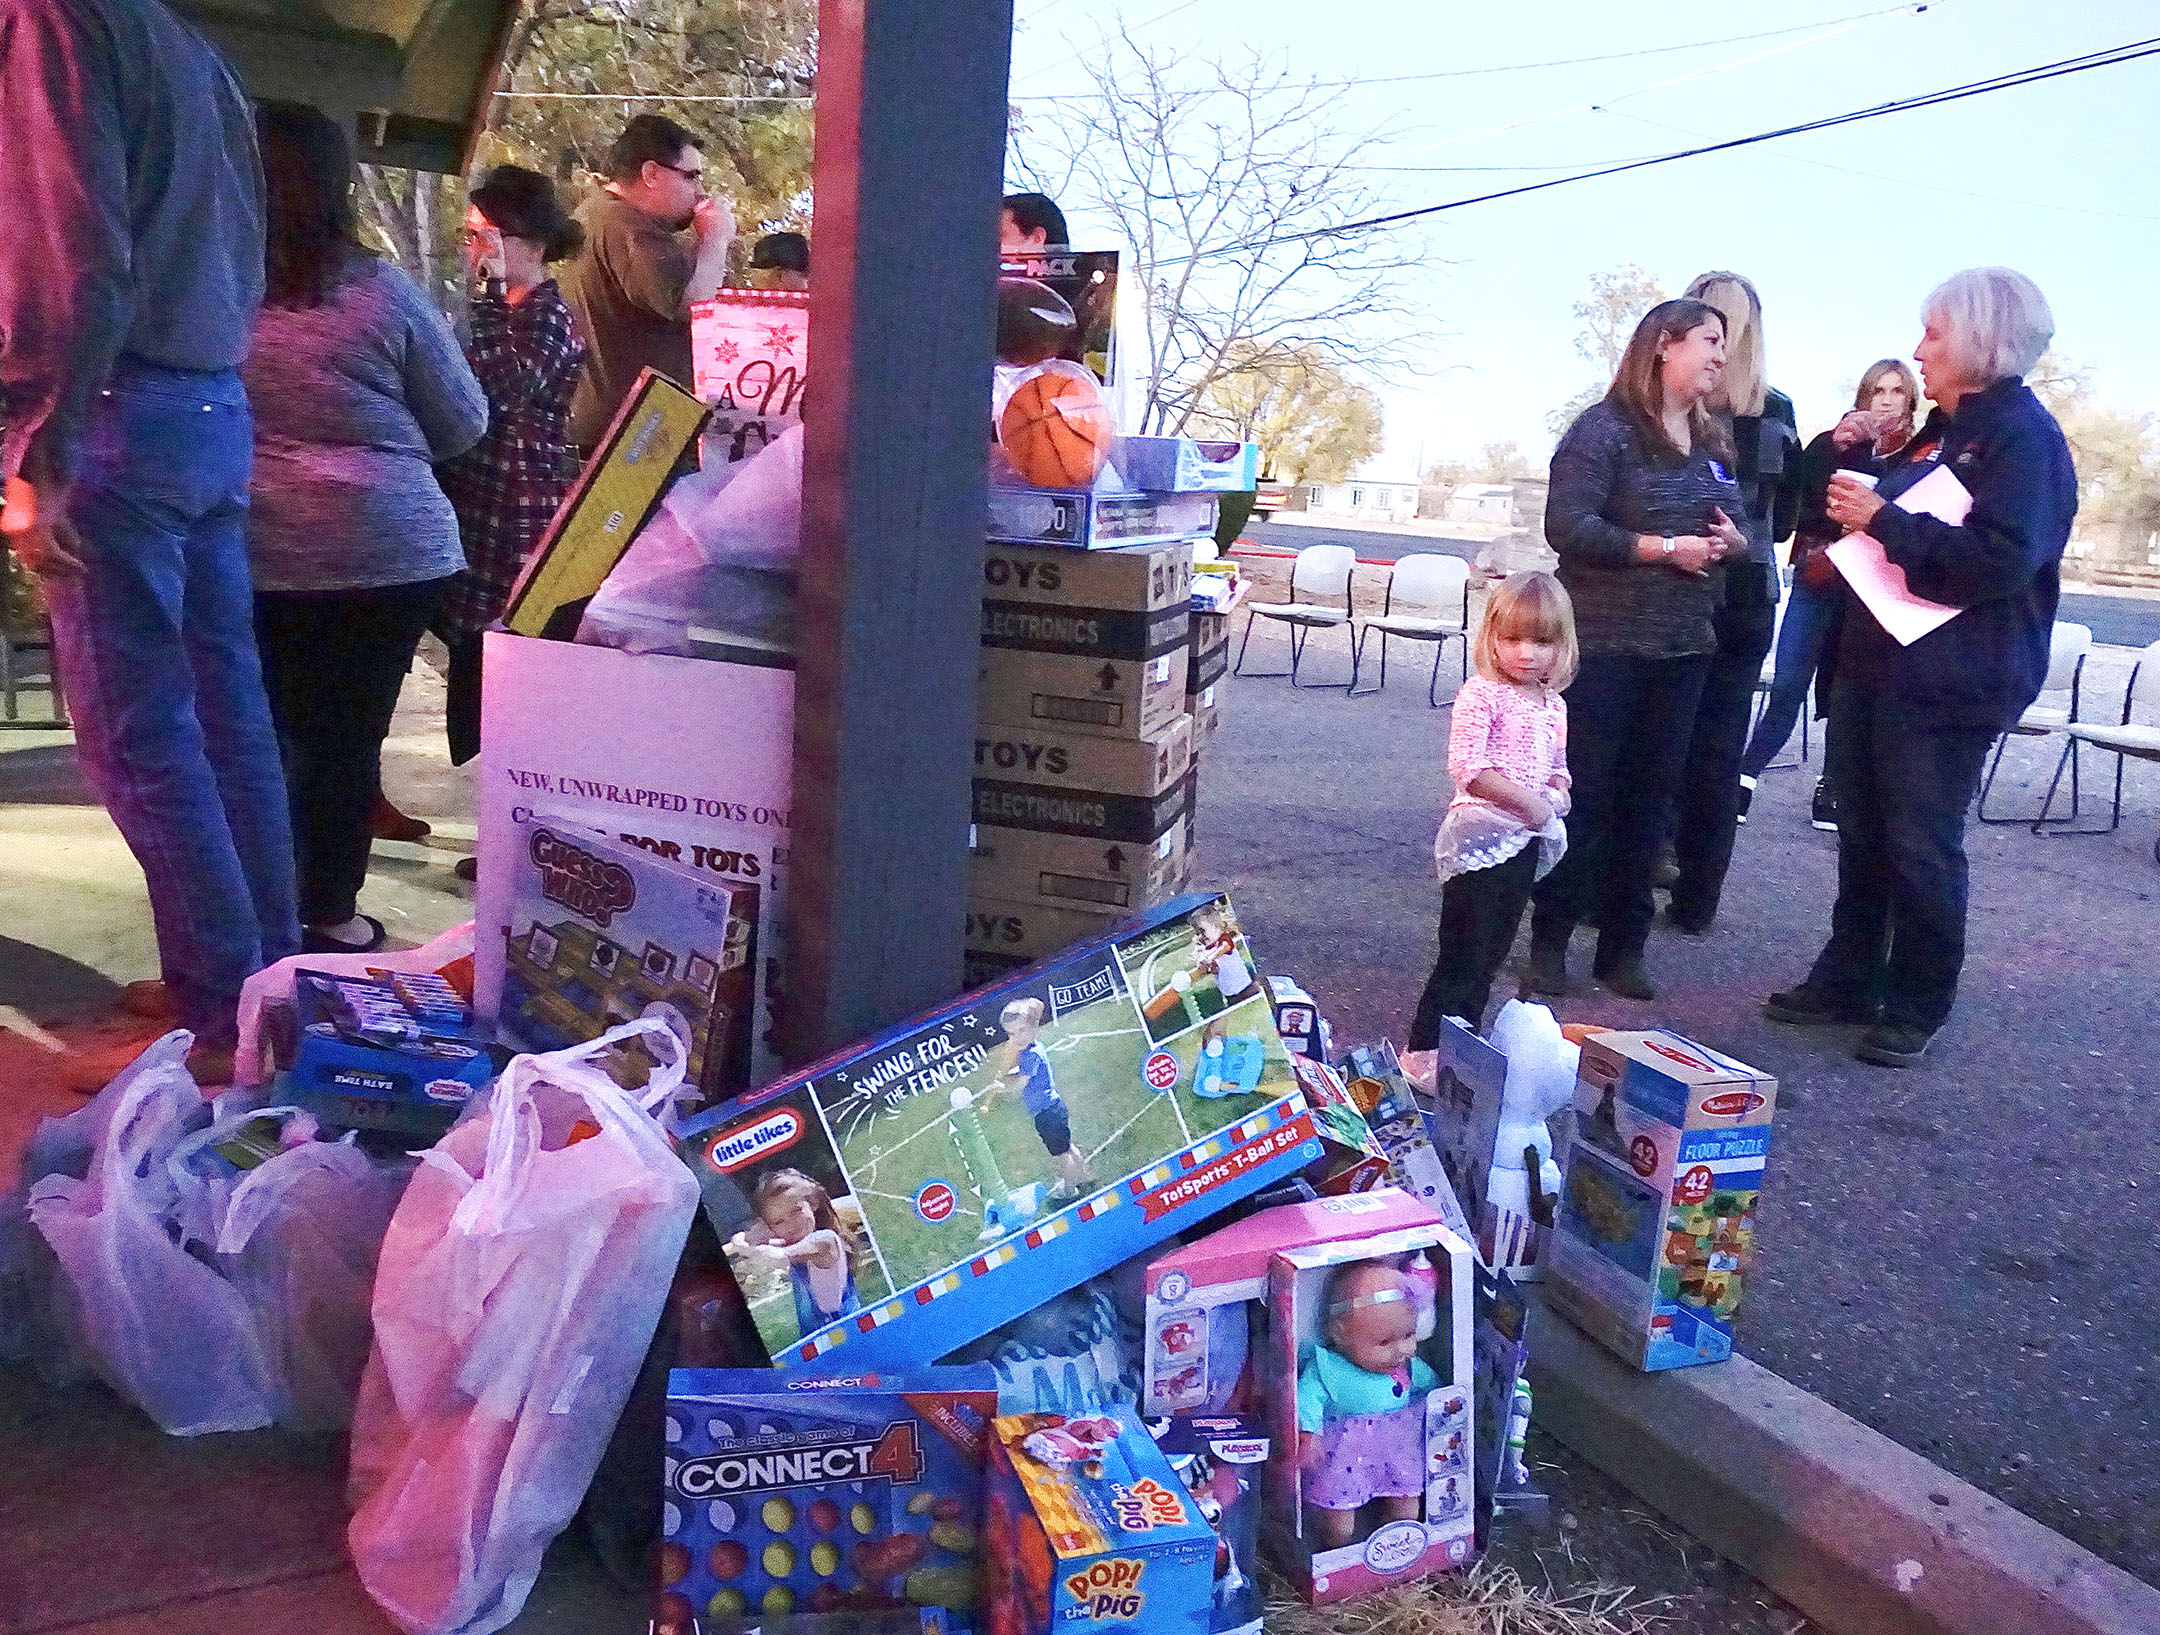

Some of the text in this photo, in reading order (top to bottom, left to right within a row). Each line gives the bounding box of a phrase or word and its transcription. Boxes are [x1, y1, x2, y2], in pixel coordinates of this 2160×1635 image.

[714, 382, 739, 411] A
[984, 557, 1062, 591] OYS
[981, 611, 1099, 644] LECTRONICS
[558, 776, 688, 813] UNWRAPPED
[693, 797, 748, 823] TOYS
[690, 844, 761, 878] TOTS
[1056, 974, 1109, 1006] GO TEAM!
[916, 1034, 957, 1066] FOR
[884, 1084, 908, 1106] THE
[907, 1043, 988, 1098] FENCES!!
[715, 1120, 794, 1163] little tikes
[1232, 1139, 1275, 1170] T-Ball
[1276, 1126, 1299, 1148] Set
[1684, 1138, 1764, 1161] FLOOR PUZZLE
[1684, 1171, 1710, 1191] 42
[787, 1377, 862, 1391] CONNECT
[682, 1421, 925, 1494] CONNECT 4
[1067, 1561, 1143, 1600] POP!
